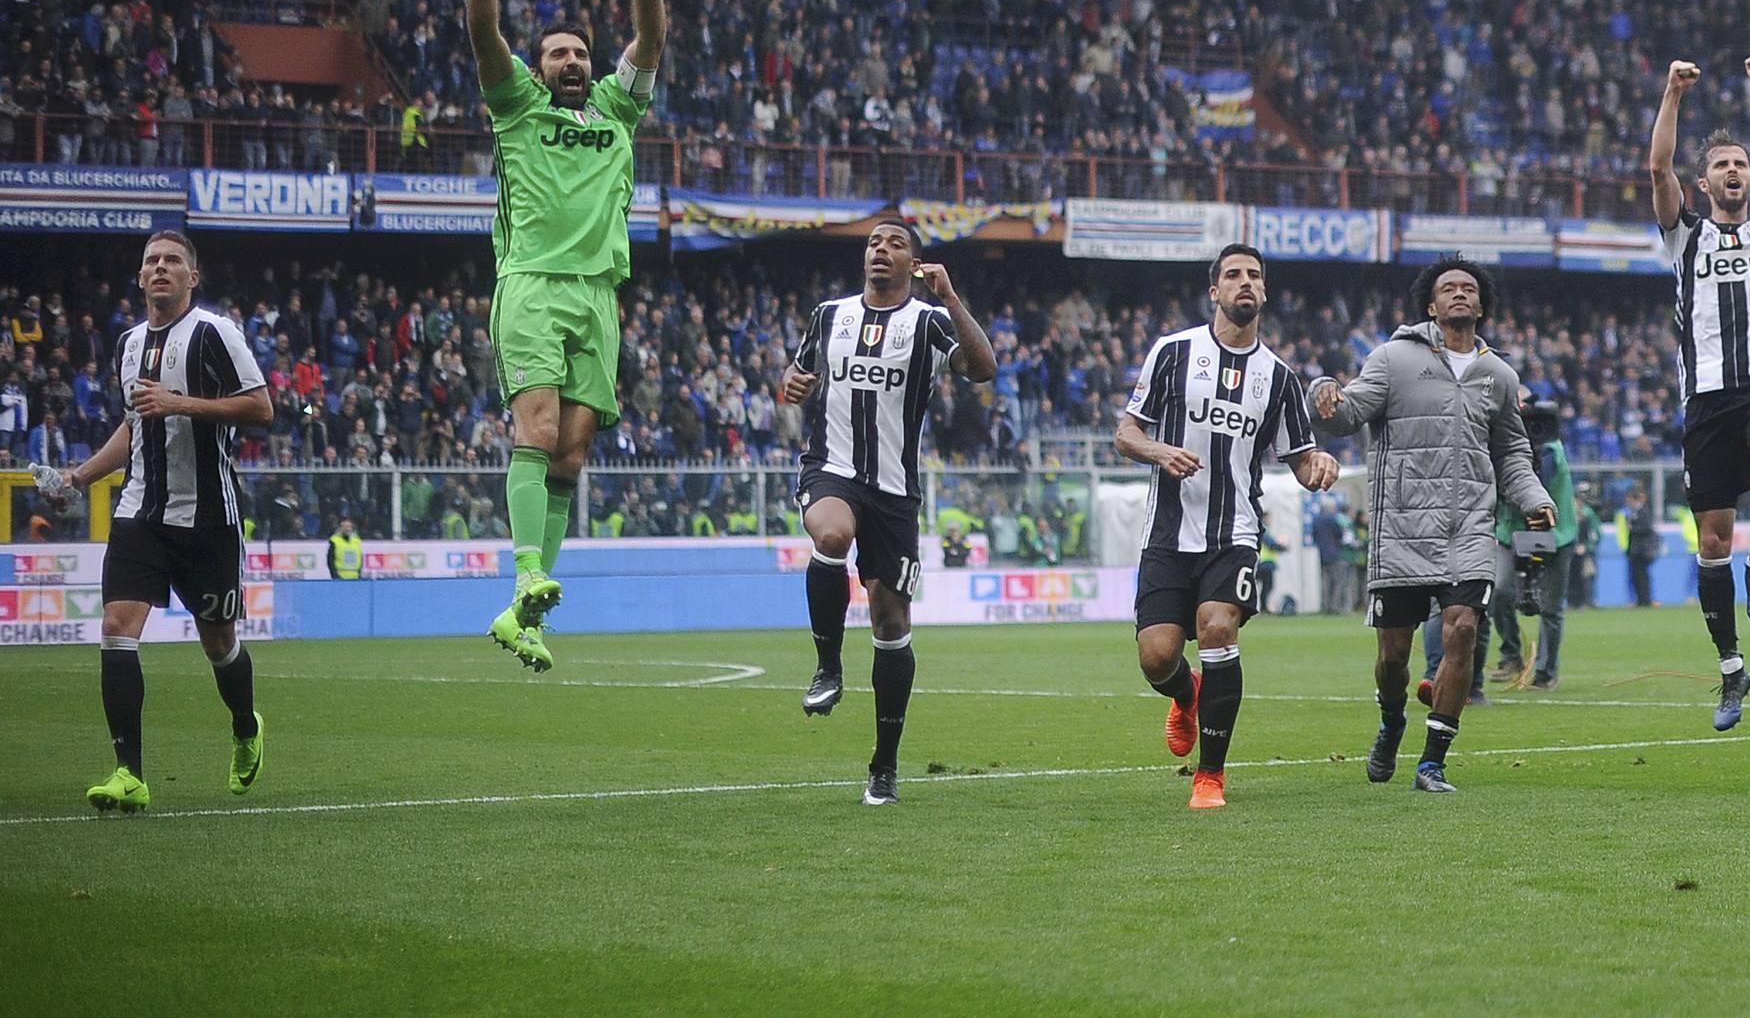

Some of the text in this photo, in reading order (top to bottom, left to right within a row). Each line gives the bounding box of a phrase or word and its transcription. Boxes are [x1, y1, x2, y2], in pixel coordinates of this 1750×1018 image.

[540, 122, 614, 153] Jeep
[190, 169, 349, 215] VERONA
[401, 176, 478, 193] TOGHE
[104, 212, 153, 229] CLUB
[1258, 213, 1369, 257] RECCO
[832, 356, 906, 391] Jeep
[1189, 397, 1258, 438] Jeep
[896, 556, 920, 595] 18
[970, 572, 1098, 600] PLAY
[1235, 566, 1253, 601] 6
[199, 589, 236, 621] 20
[985, 603, 1084, 620] FOR CHANGE
[0, 622, 86, 643] CHANGE
